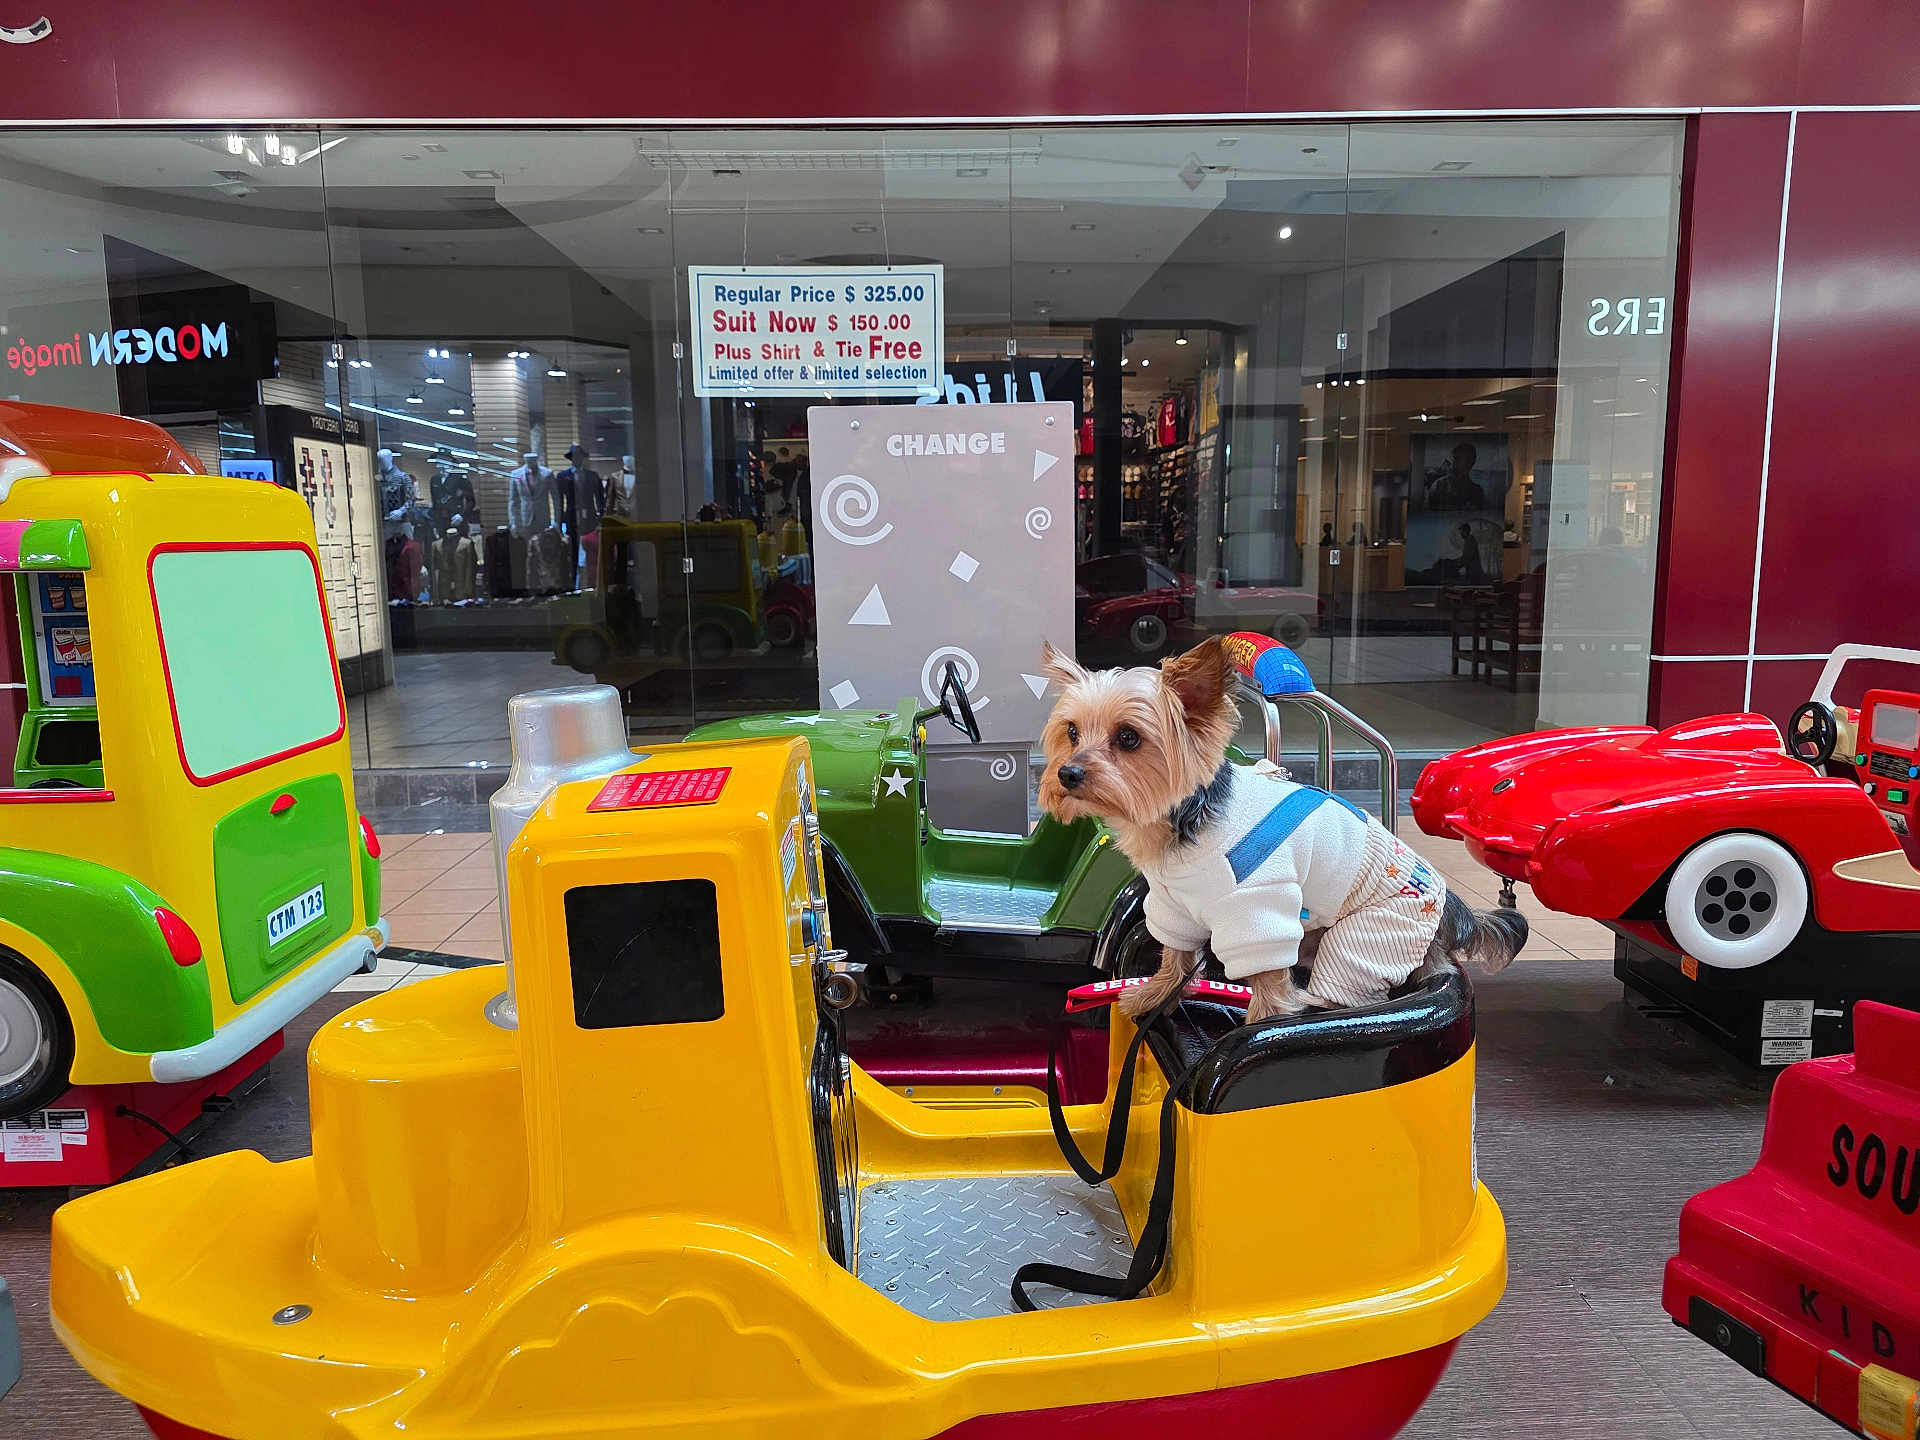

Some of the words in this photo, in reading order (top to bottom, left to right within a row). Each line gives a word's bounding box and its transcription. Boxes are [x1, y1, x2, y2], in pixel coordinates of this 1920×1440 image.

[714, 284, 781, 306] Regular
[790, 284, 836, 303] Price
[844, 284, 856, 304] $
[864, 284, 924, 303] 325.00
[712, 308, 757, 333] Suit
[768, 310, 817, 333] Now
[828, 314, 838, 332] $
[714, 343, 751, 361] Plus
[760, 342, 801, 360] Shirt
[813, 340, 825, 358] &
[835, 340, 863, 358] Tie
[868, 335, 923, 360] Free
[708, 365, 759, 380] Limited
[763, 364, 794, 380] offer
[799, 366, 809, 380] &
[814, 365, 859, 380] limited
[865, 365, 928, 380] selection
[886, 431, 1006, 457] CHANGE
[269, 905, 296, 937] CTM
[300, 890, 323, 920] 123
[1800, 1283, 1896, 1358] KID
